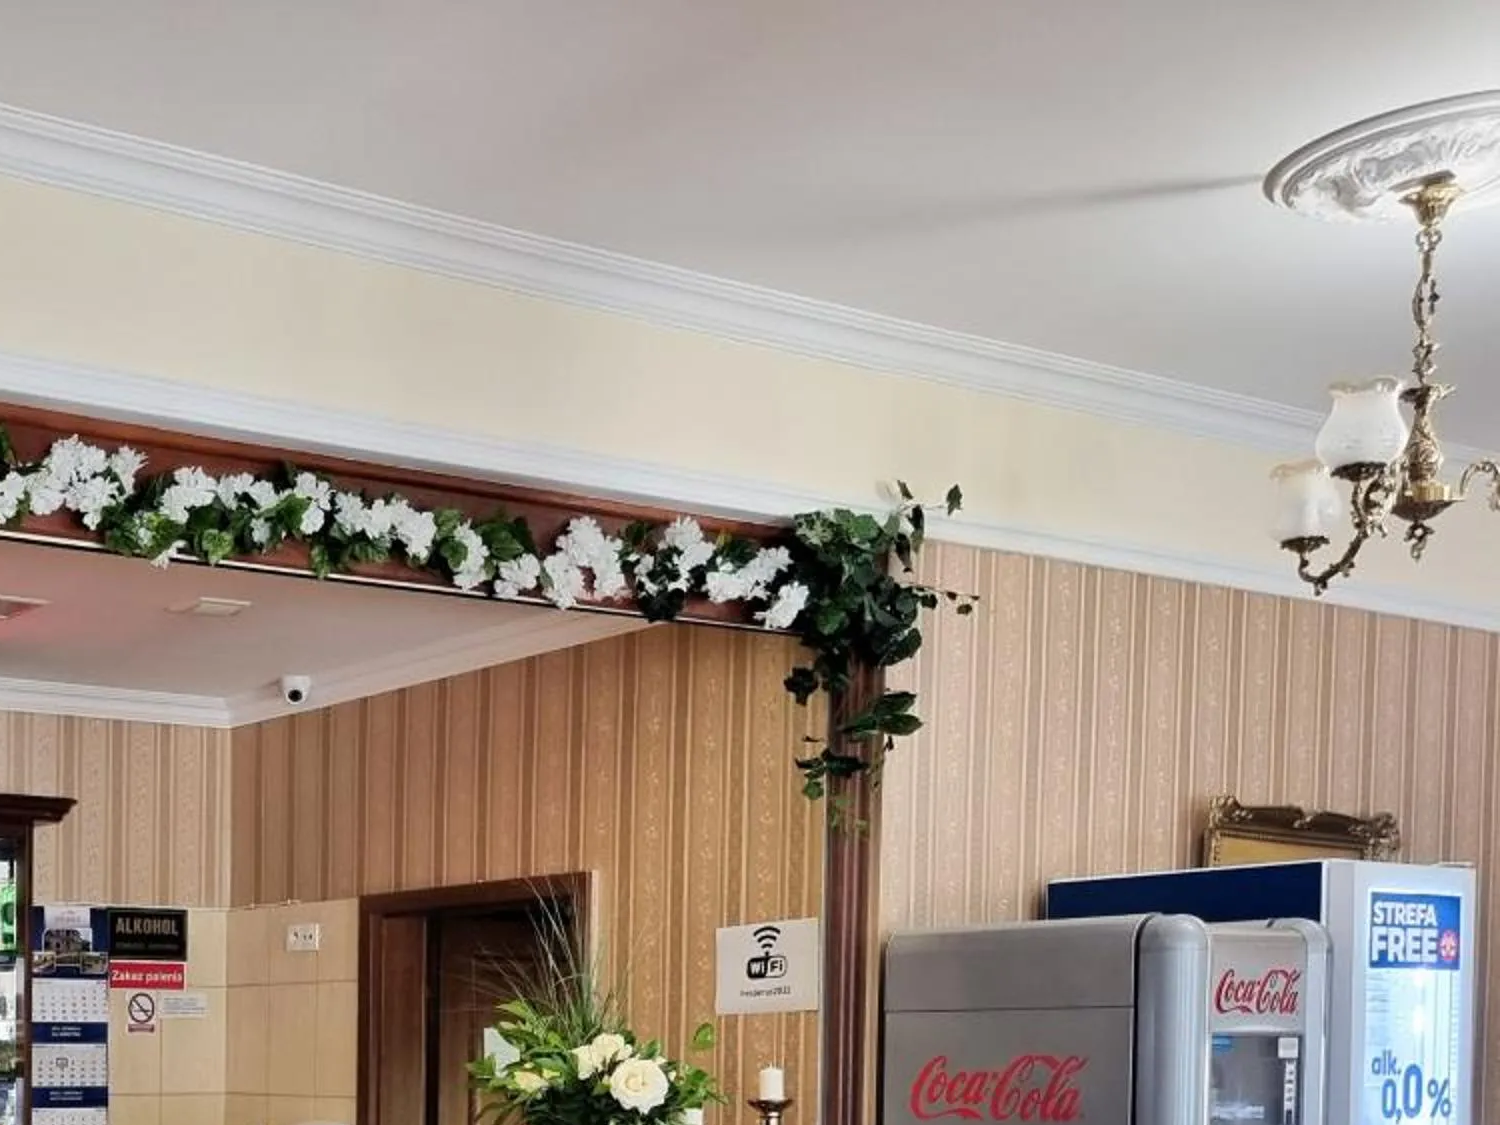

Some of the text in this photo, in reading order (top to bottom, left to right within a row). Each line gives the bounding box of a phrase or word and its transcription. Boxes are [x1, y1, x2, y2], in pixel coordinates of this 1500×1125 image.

[115, 917, 179, 936] ALKOHOL
[1372, 901, 1438, 926] STREFA
[1370, 926, 1439, 963] FREE
[111, 970, 143, 981] Zakaz
[1214, 968, 1302, 1014] Coca-Cola
[1371, 1050, 1402, 1077] alk.
[910, 1054, 1090, 1122] Coca-Cola
